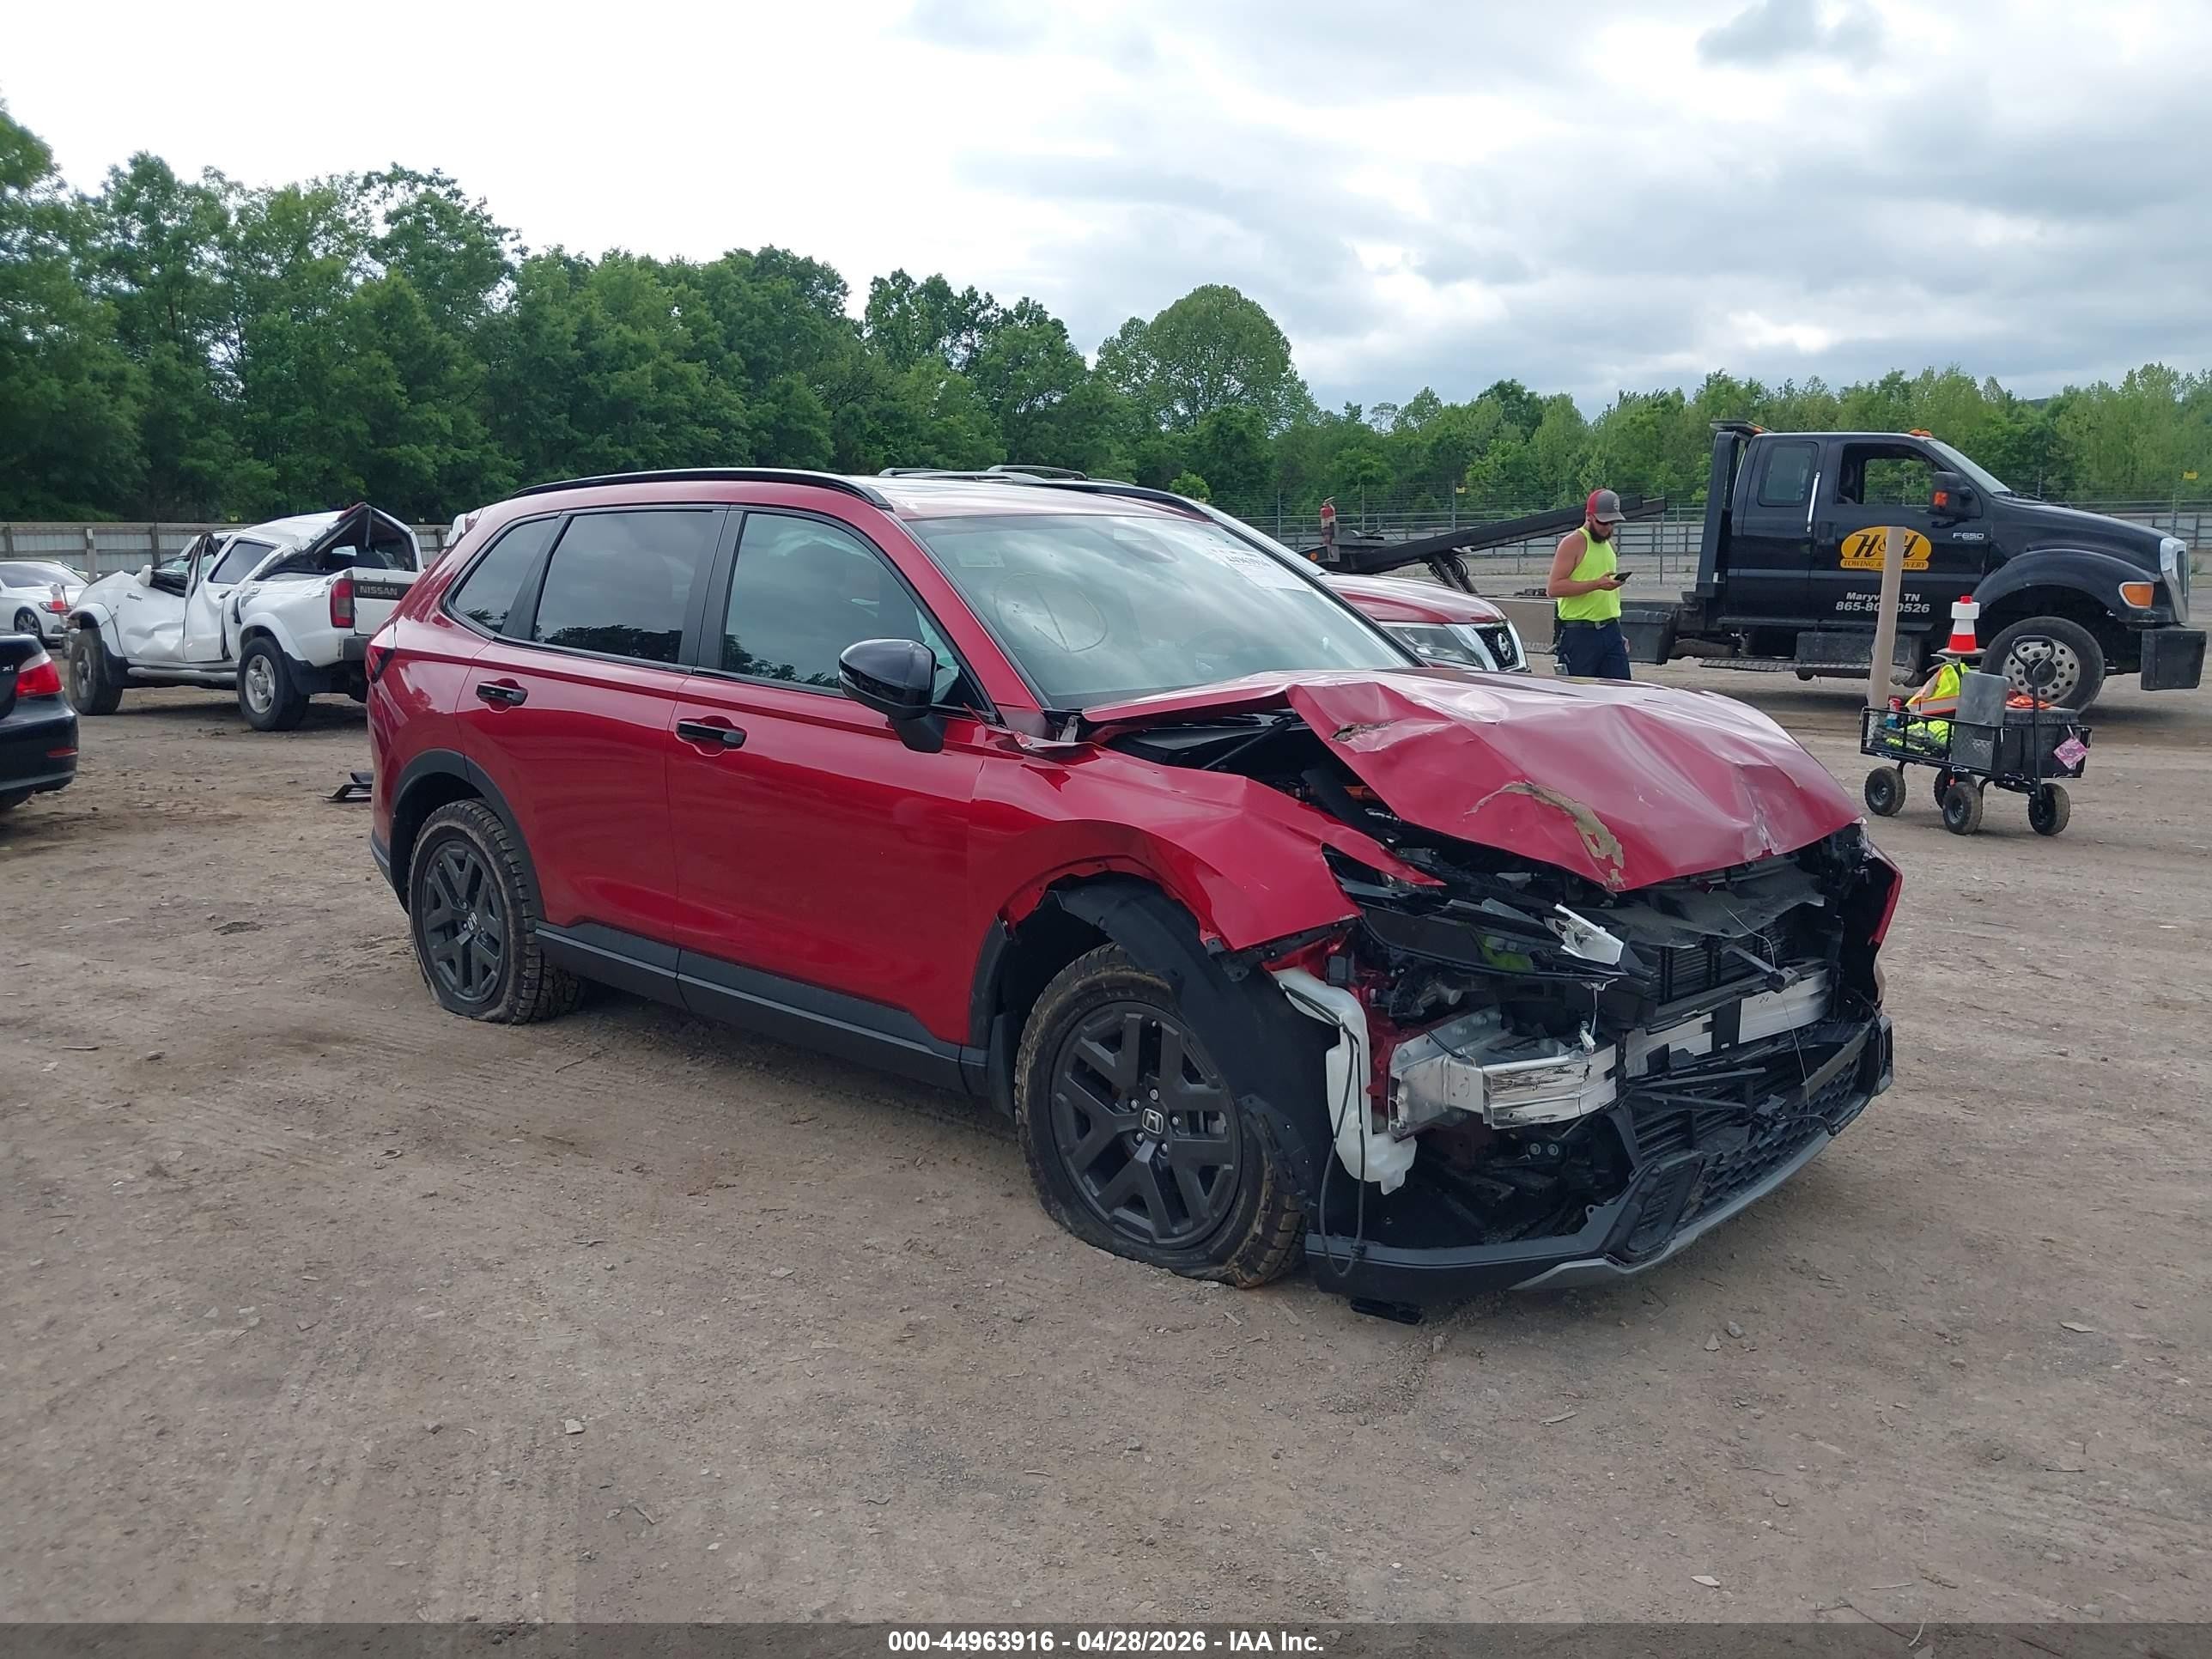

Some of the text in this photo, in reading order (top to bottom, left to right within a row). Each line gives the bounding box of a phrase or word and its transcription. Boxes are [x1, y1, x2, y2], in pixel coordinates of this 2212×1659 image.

[1952, 532, 1984, 540] F650
[359, 585, 398, 596] NISSAN
[1904, 593, 1921, 602] TN
[1835, 601, 1931, 614] 865-800526
